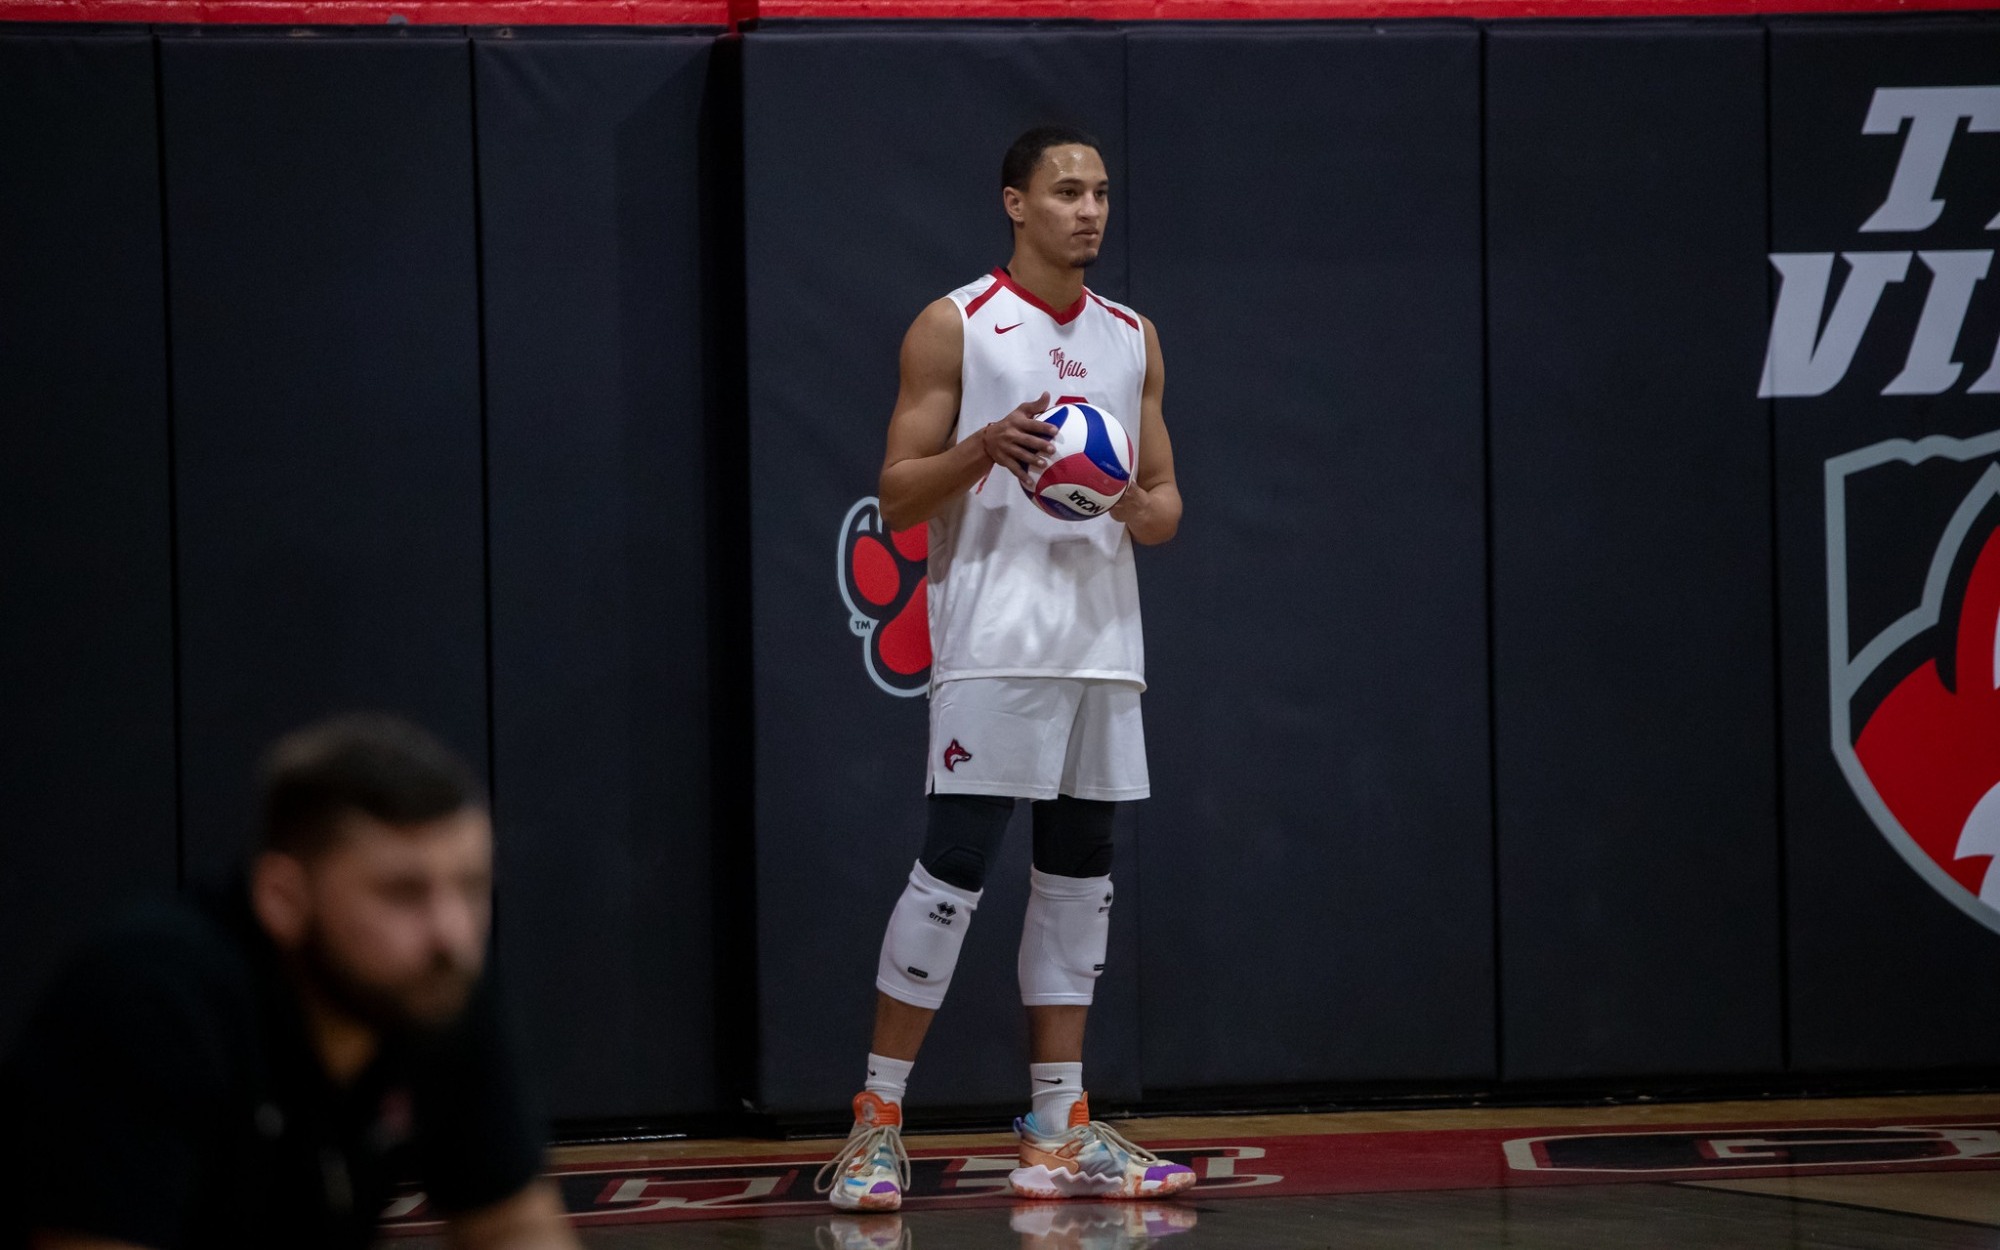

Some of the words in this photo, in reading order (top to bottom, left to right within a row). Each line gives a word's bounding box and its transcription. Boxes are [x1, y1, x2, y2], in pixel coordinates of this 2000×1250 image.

[1858, 85, 2000, 232] T
[1049, 347, 1065, 365] The
[1056, 360, 1087, 380] Ville
[1068, 490, 1105, 514] NCAA
[855, 620, 871, 630] TM
